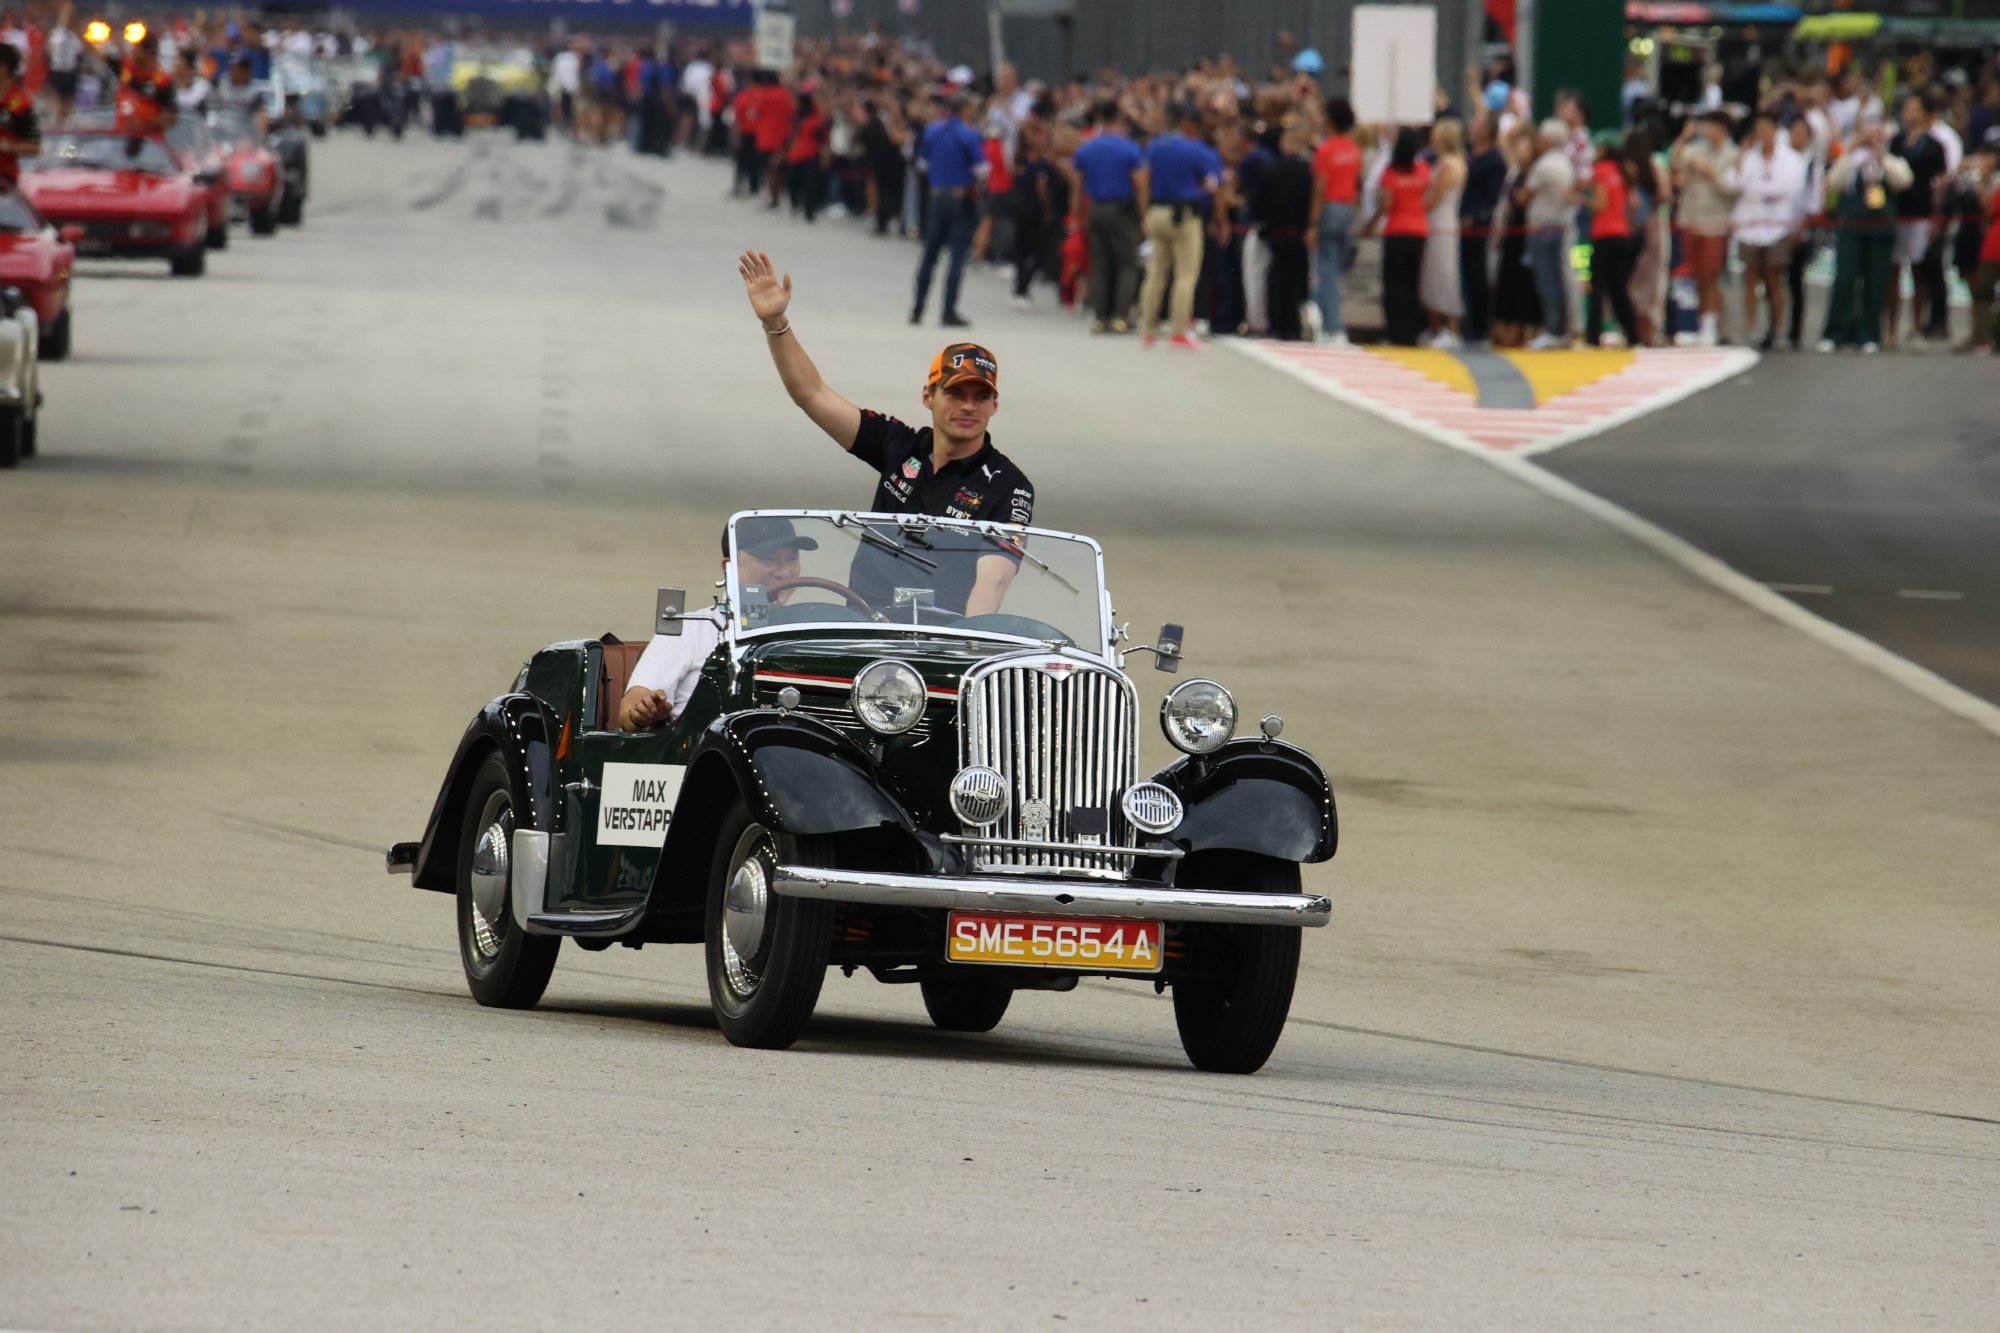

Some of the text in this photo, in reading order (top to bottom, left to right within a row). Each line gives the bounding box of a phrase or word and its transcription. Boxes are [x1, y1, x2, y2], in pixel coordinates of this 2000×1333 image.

[952, 354, 964, 368] 1
[884, 480, 907, 504] ORACLE
[946, 505, 972, 520] BYBIT
[632, 779, 667, 803] MAX
[604, 806, 673, 832] VERSTAPP
[955, 921, 1152, 960] SME 5654 A
